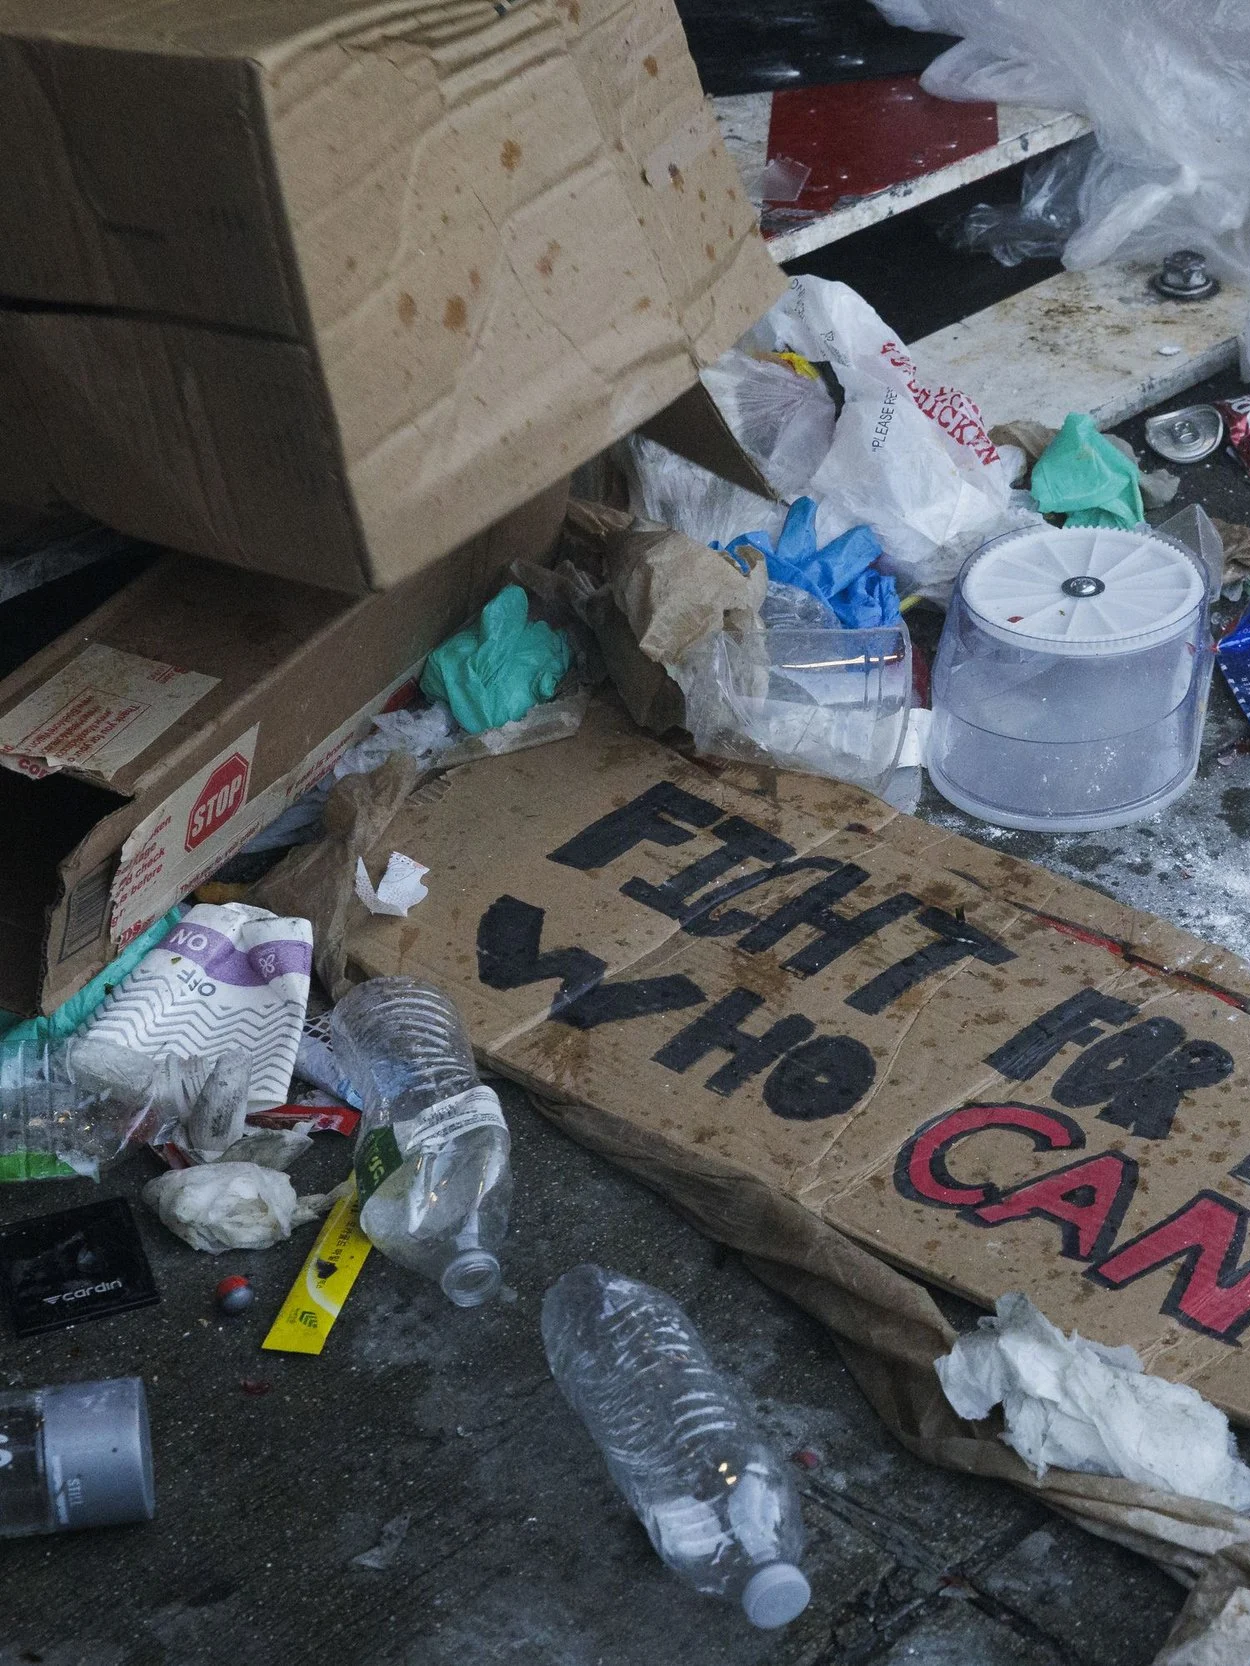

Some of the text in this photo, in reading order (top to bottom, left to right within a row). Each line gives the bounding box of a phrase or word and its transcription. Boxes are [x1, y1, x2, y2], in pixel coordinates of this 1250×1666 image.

[190, 773, 243, 838] STOP
[168, 928, 207, 951] ON
[546, 781, 1016, 1015] FIGHT
[985, 987, 1234, 1140] FOR
[176, 968, 216, 997] OFF
[477, 894, 876, 1121] WHO
[62, 1280, 122, 1301] cardin
